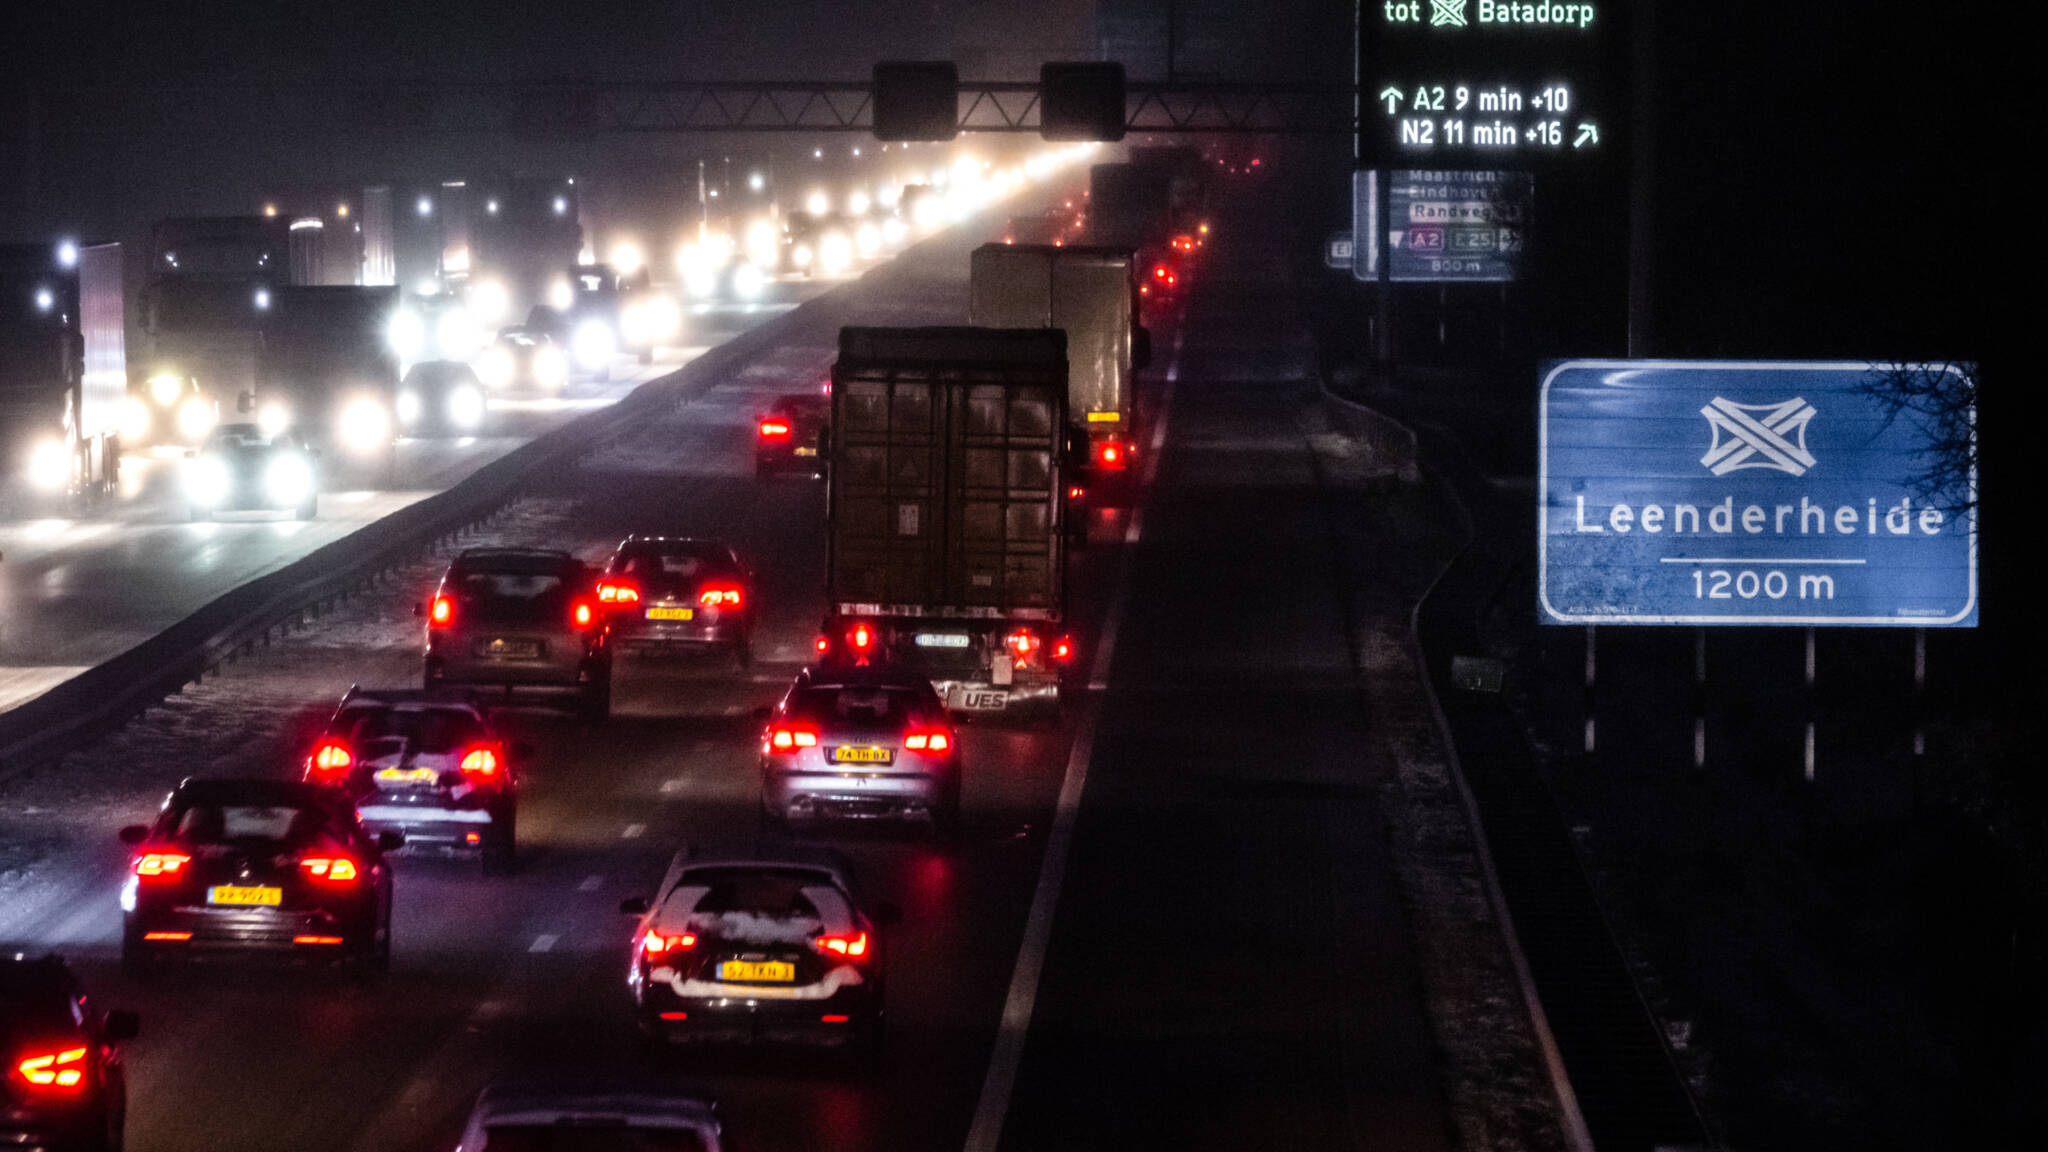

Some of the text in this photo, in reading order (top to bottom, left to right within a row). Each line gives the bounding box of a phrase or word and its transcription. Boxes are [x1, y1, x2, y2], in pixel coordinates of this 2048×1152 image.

[1384, 0, 1594, 28] tot Batadorp
[1414, 86, 1569, 112] A2 9 min +10
[1402, 120, 1562, 145] N2 11 min +16
[1409, 170, 1504, 182] Maastrich
[1431, 260, 1480, 272] 800 m
[1576, 495, 1944, 535] Leenderheide
[1692, 570, 1834, 600] 1200 m
[964, 693, 1004, 708] UES
